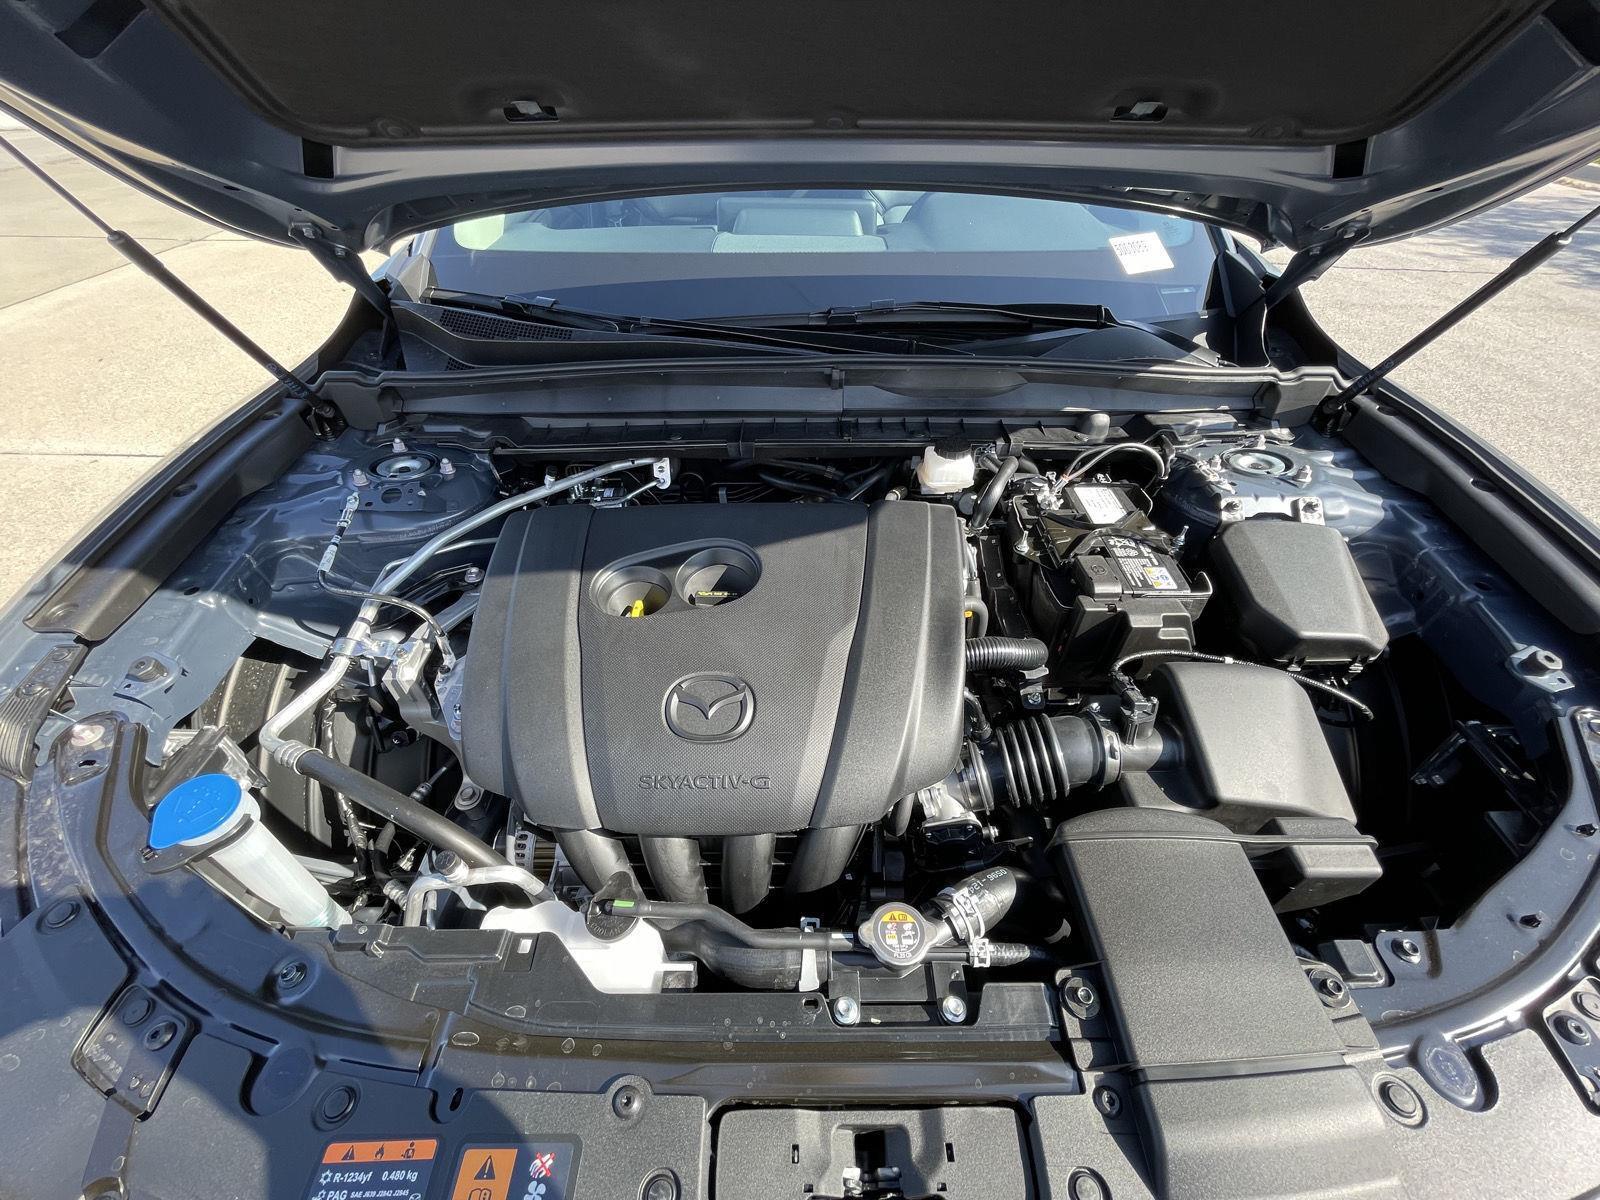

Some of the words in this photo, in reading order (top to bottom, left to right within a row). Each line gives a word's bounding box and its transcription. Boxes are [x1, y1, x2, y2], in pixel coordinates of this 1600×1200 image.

[638, 774, 771, 790] SKYACTIV-G
[333, 1171, 373, 1184] R-1234yf
[382, 1170, 405, 1181] 0.480
[406, 1169, 418, 1182] kg
[326, 1190, 348, 1200] PAG
